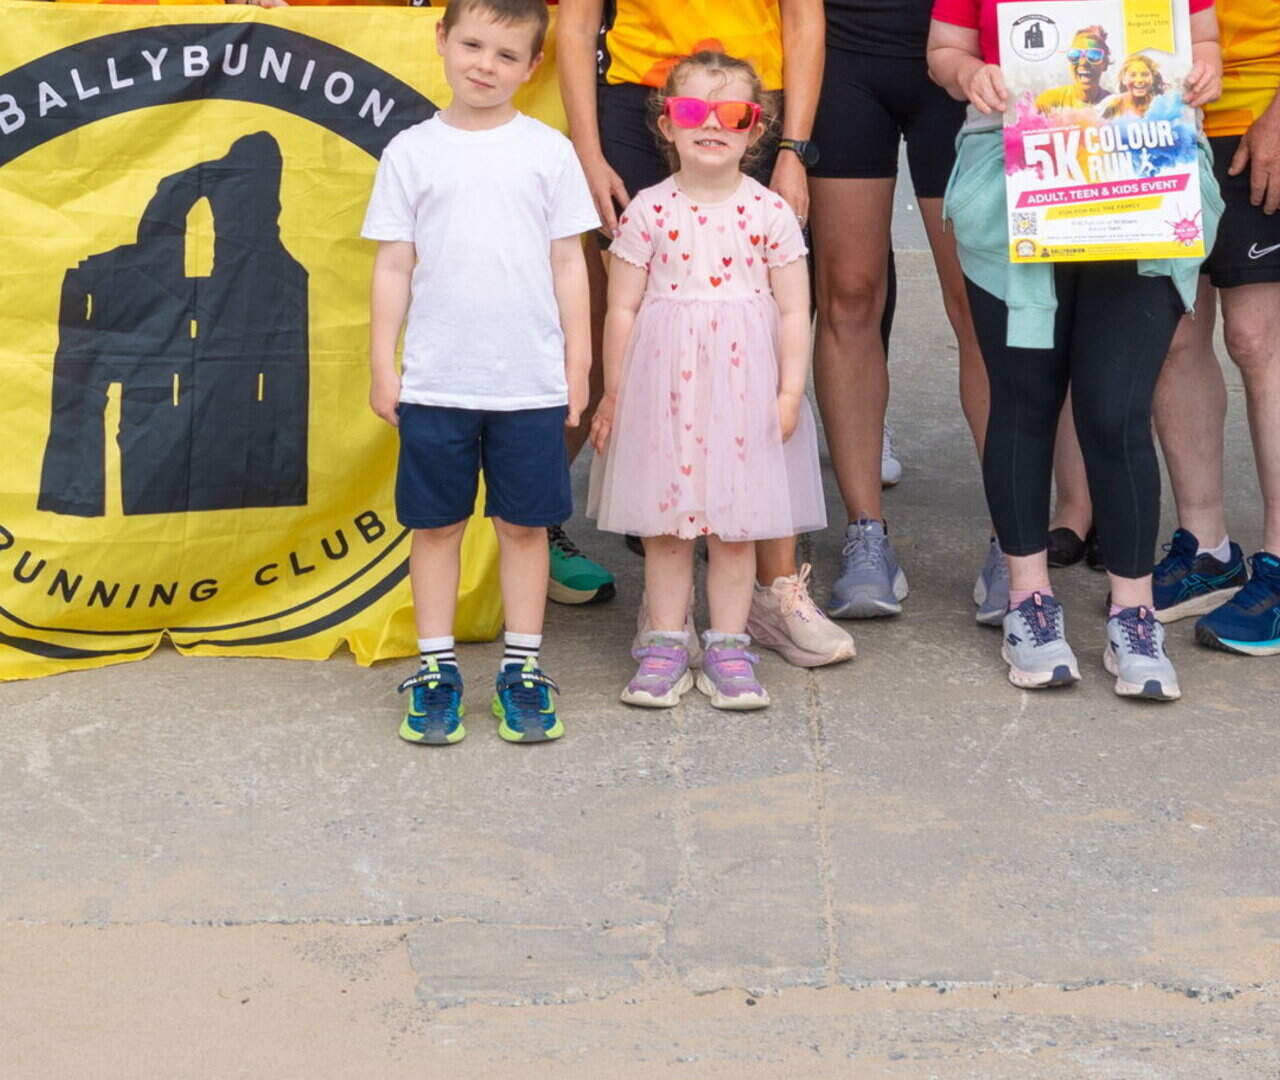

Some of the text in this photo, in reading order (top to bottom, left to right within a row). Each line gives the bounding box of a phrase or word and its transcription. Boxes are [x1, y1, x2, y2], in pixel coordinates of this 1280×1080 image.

[1084, 120, 1175, 153] COLOUR
[1022, 131, 1086, 183] 5K
[1087, 150, 1135, 181] RUN
[1027, 180, 1178, 205] ADULT, TEEN & KIDS EVENT
[253, 509, 388, 587] CLUB
